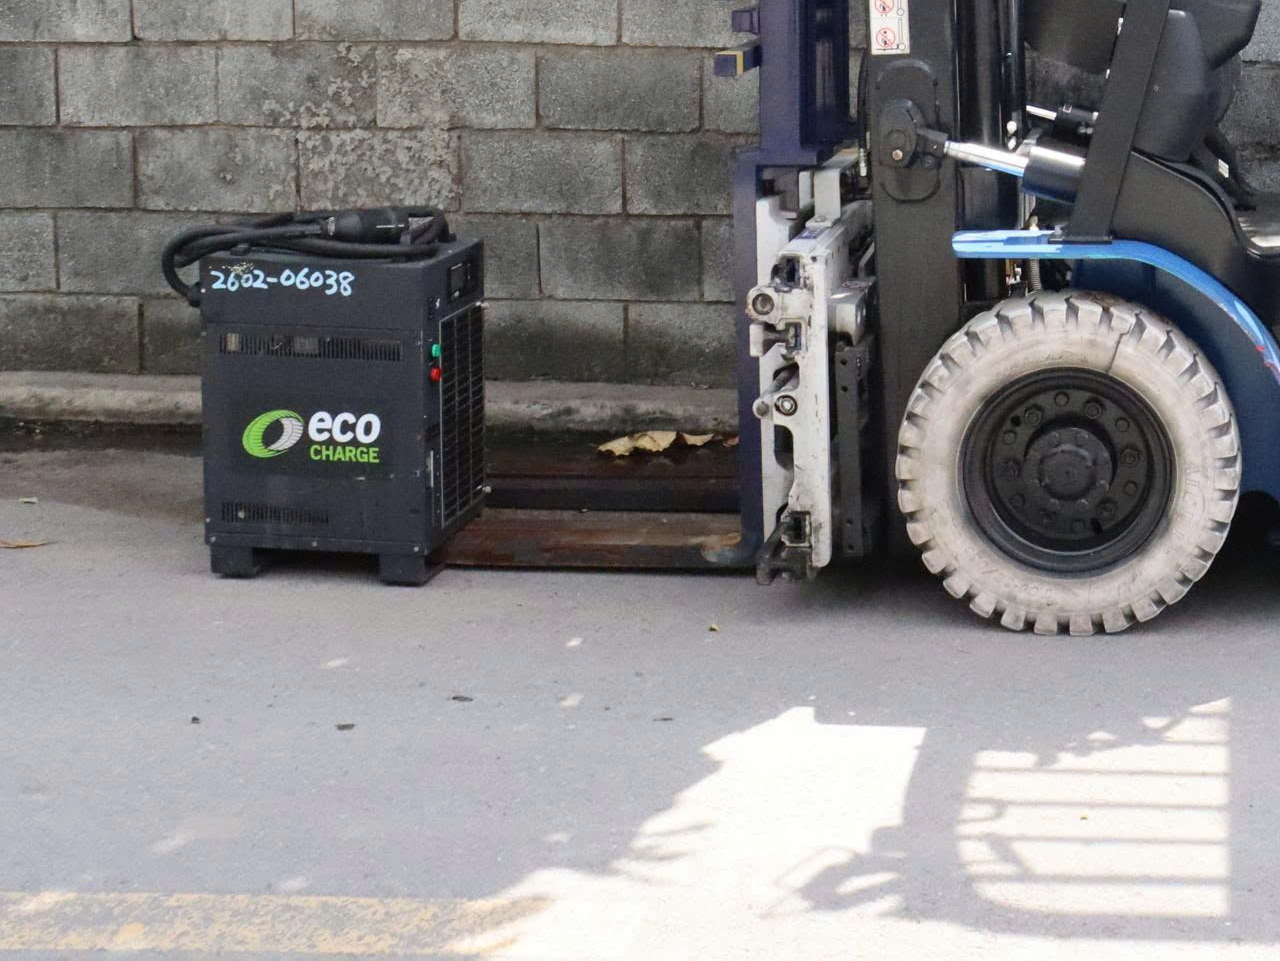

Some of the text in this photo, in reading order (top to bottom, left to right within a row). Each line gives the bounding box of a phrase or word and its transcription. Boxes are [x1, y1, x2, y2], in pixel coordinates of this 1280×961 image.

[210, 269, 356, 297] 2602-06038
[307, 410, 382, 444] eco
[309, 444, 380, 464] CHARGE
